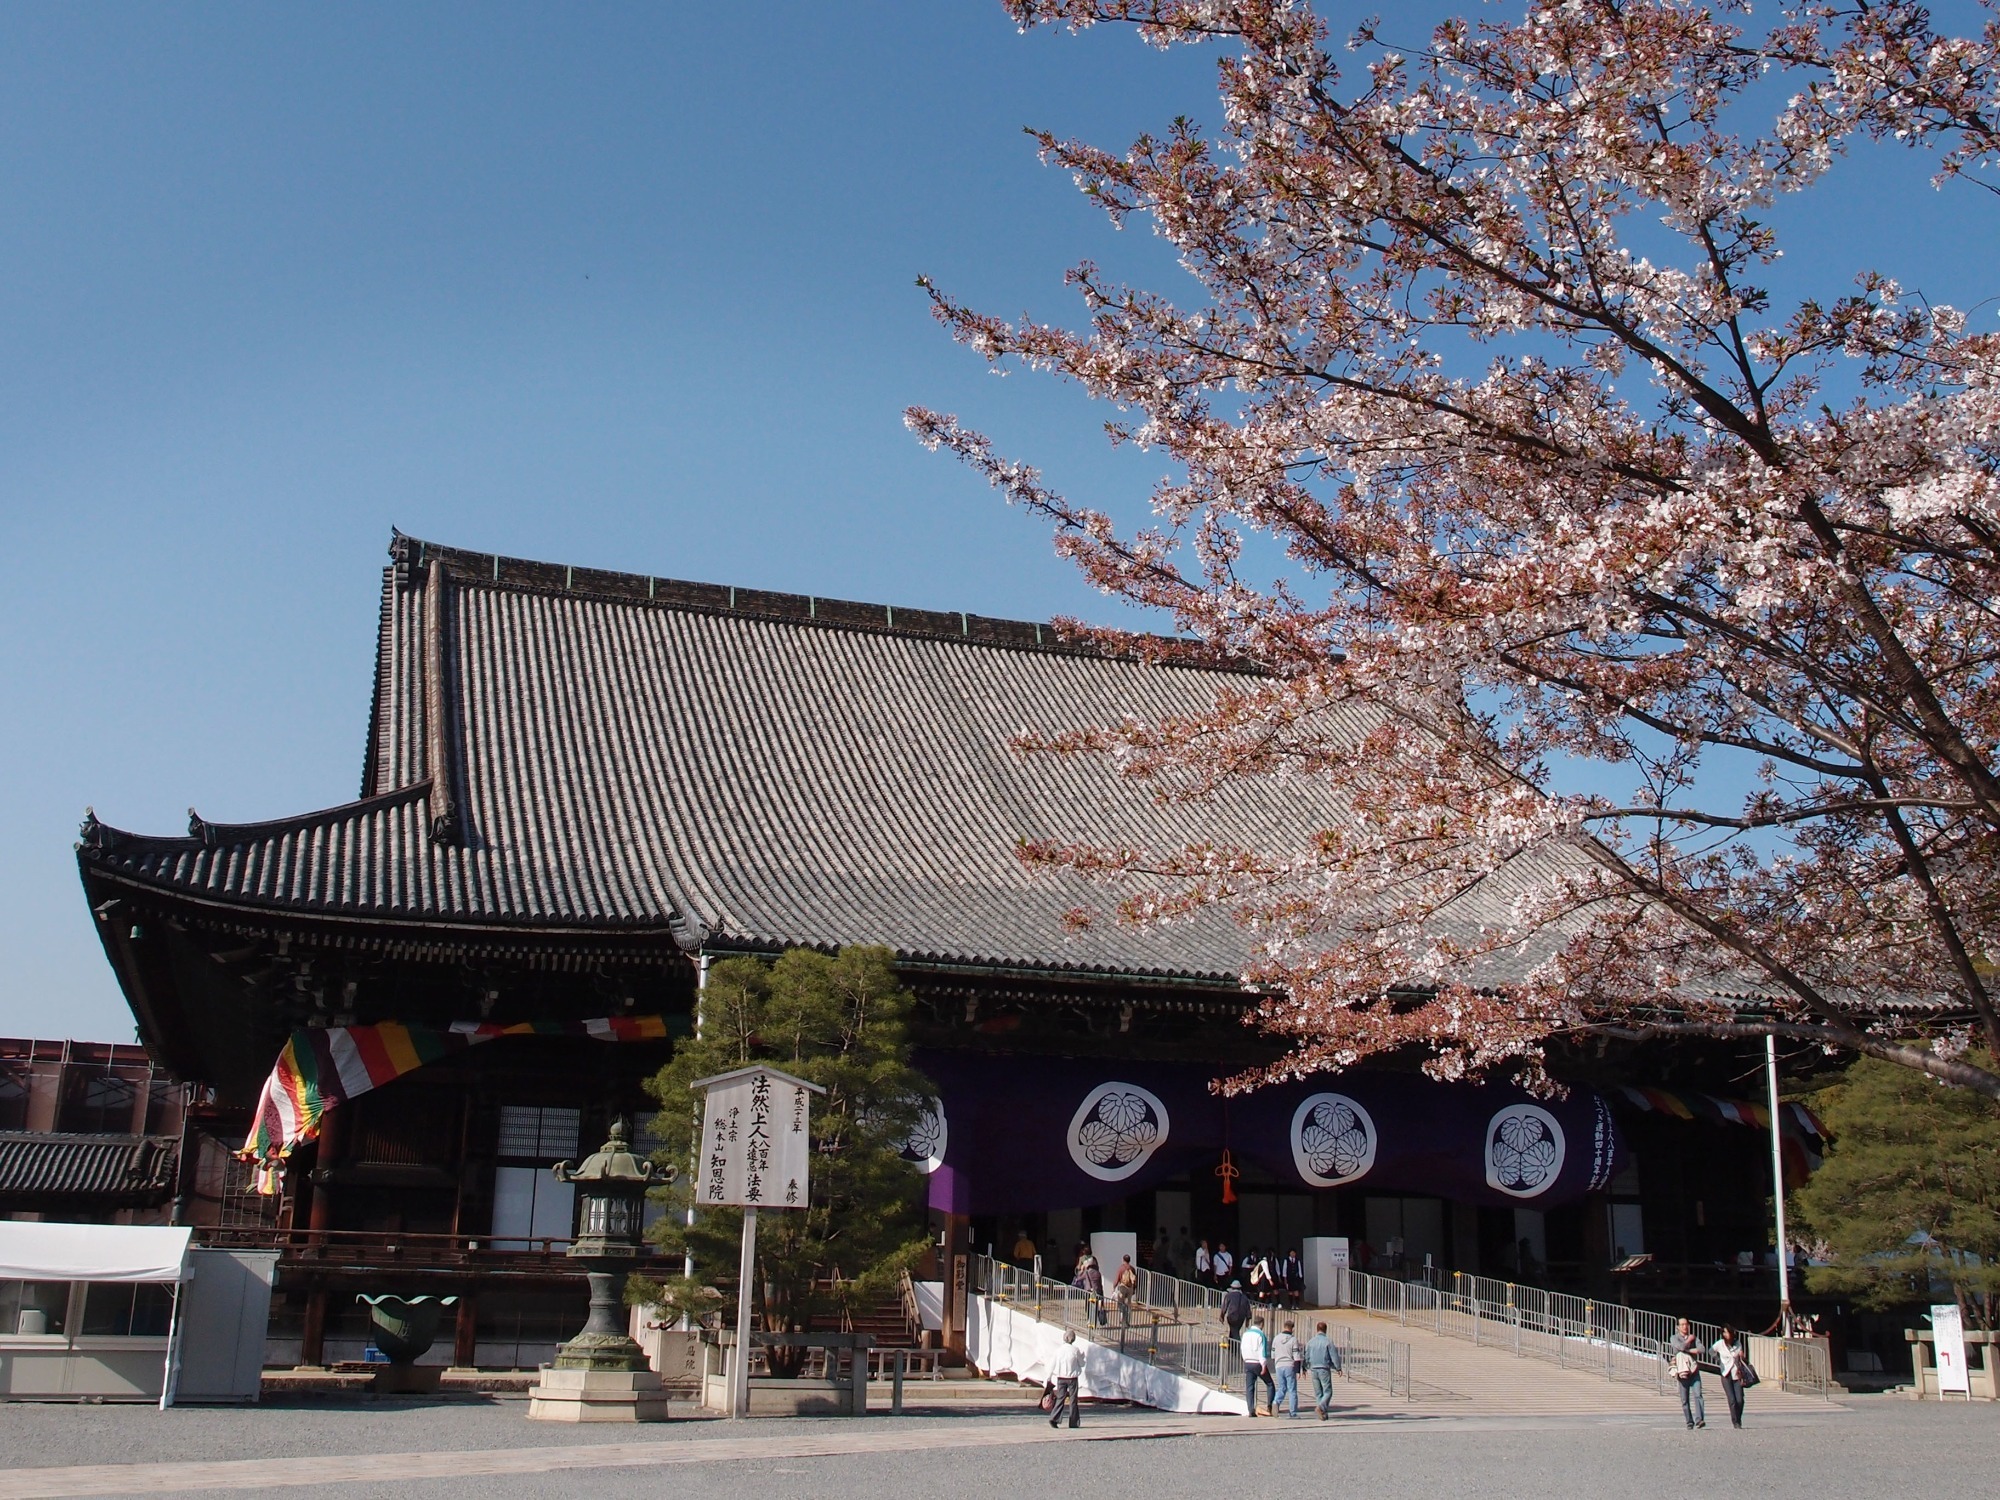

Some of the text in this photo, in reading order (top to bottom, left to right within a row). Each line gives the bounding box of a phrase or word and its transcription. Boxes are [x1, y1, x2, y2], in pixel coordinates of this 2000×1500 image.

[728, 1106, 741, 1143] 浄土宗
[747, 1074, 771, 1139] 法然上人
[792, 1087, 805, 1134] 平成二十三年
[757, 1140, 771, 1172] 八百年
[745, 1173, 763, 1203] 法要
